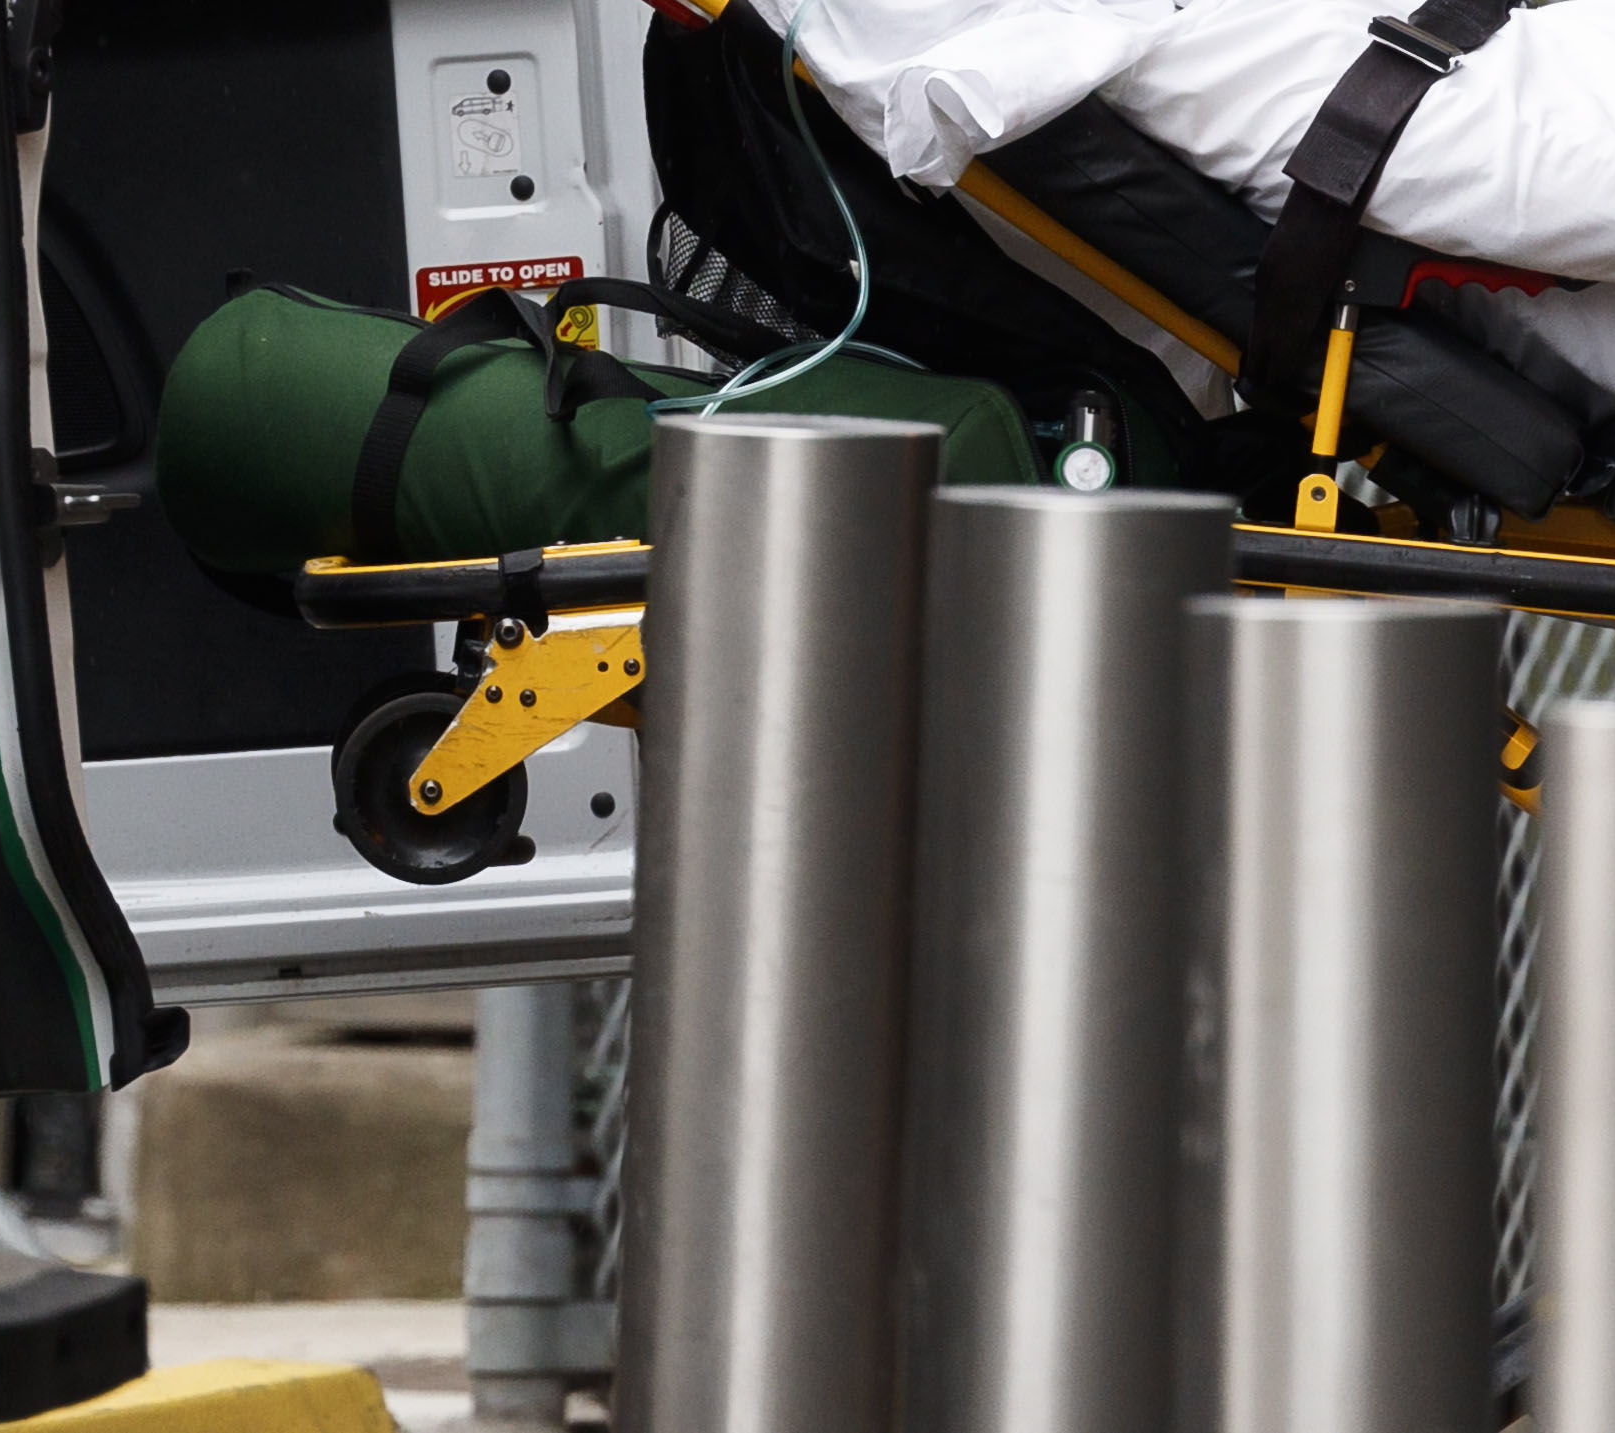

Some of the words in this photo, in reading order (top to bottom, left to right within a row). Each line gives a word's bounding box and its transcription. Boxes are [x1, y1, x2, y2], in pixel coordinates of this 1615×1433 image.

[429, 269, 484, 287] SLIDE
[488, 267, 514, 282] TO
[519, 262, 571, 280] OPEN
